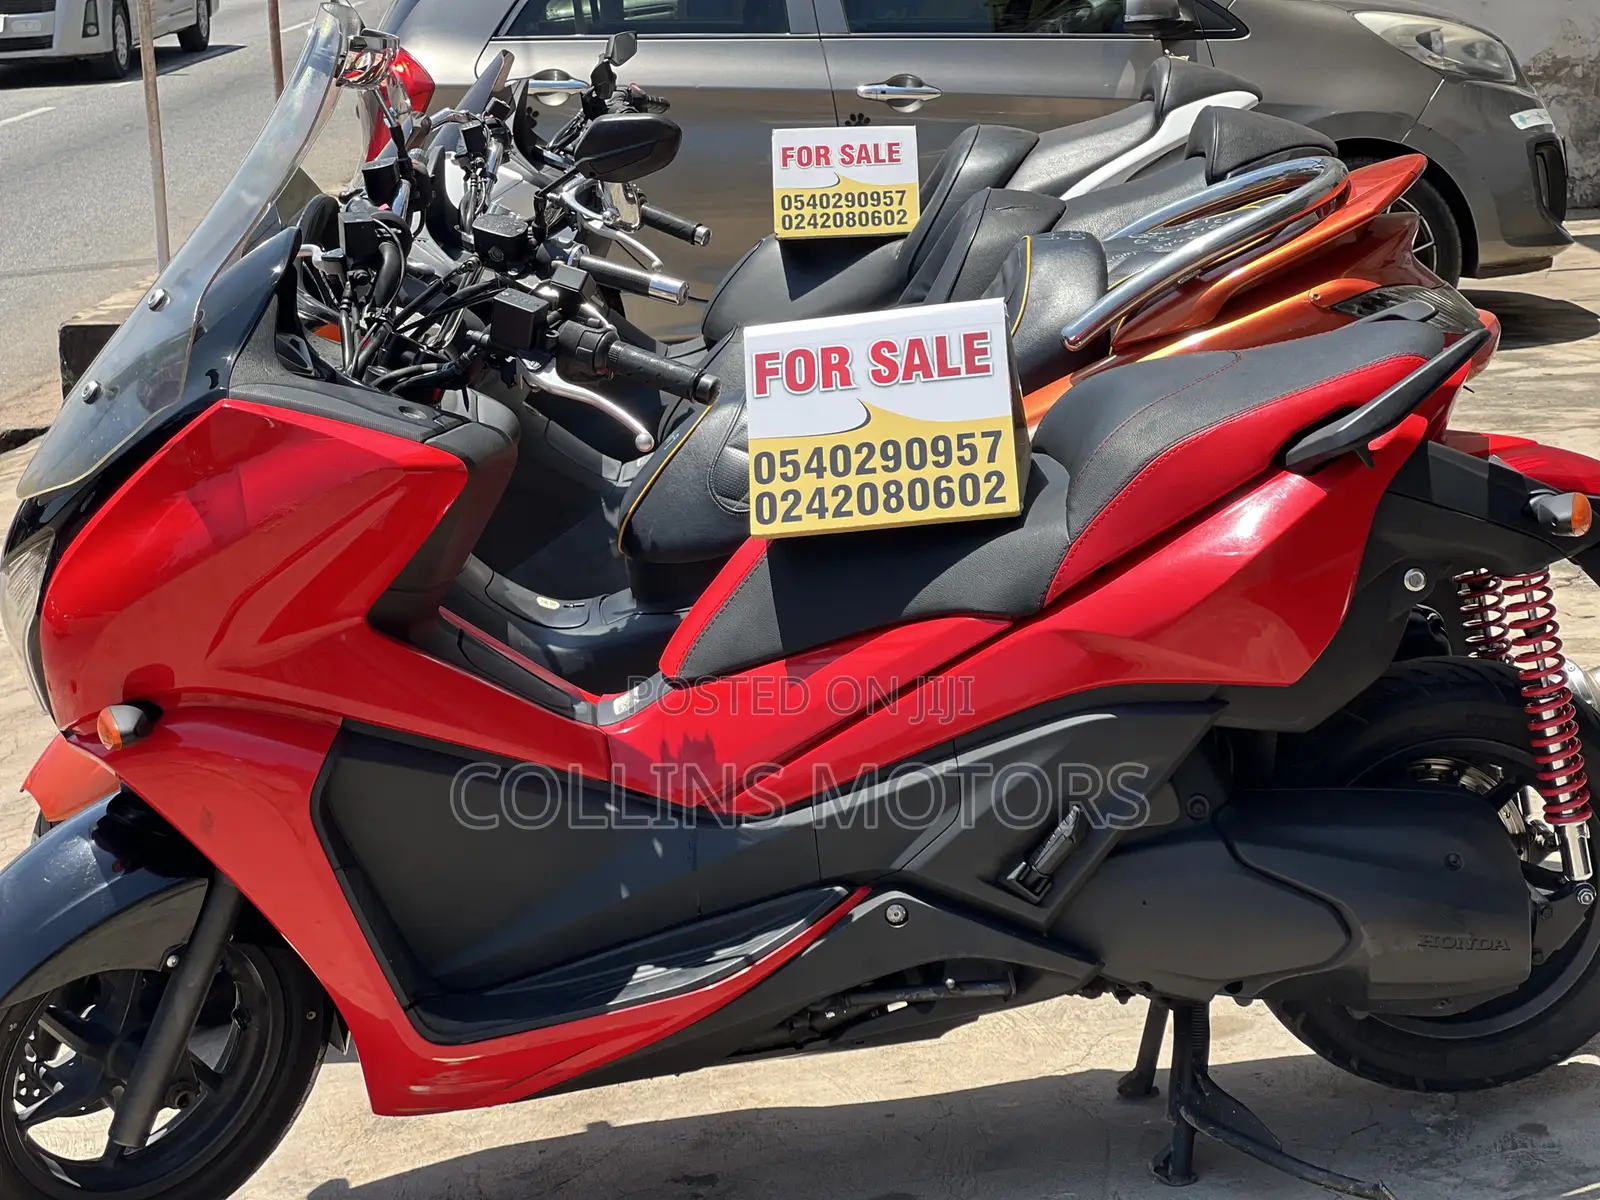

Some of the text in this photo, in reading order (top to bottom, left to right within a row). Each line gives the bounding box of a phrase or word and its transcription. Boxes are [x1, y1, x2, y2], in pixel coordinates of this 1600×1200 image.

[780, 142, 902, 168] FOR SALE
[780, 190, 907, 212] 0540290957
[781, 209, 908, 231] 0242080602
[753, 331, 992, 397] FOR SALE
[753, 429, 1003, 486] 0540290957
[755, 470, 1007, 526] 0242080602
[1417, 933, 1511, 952] HONDA
